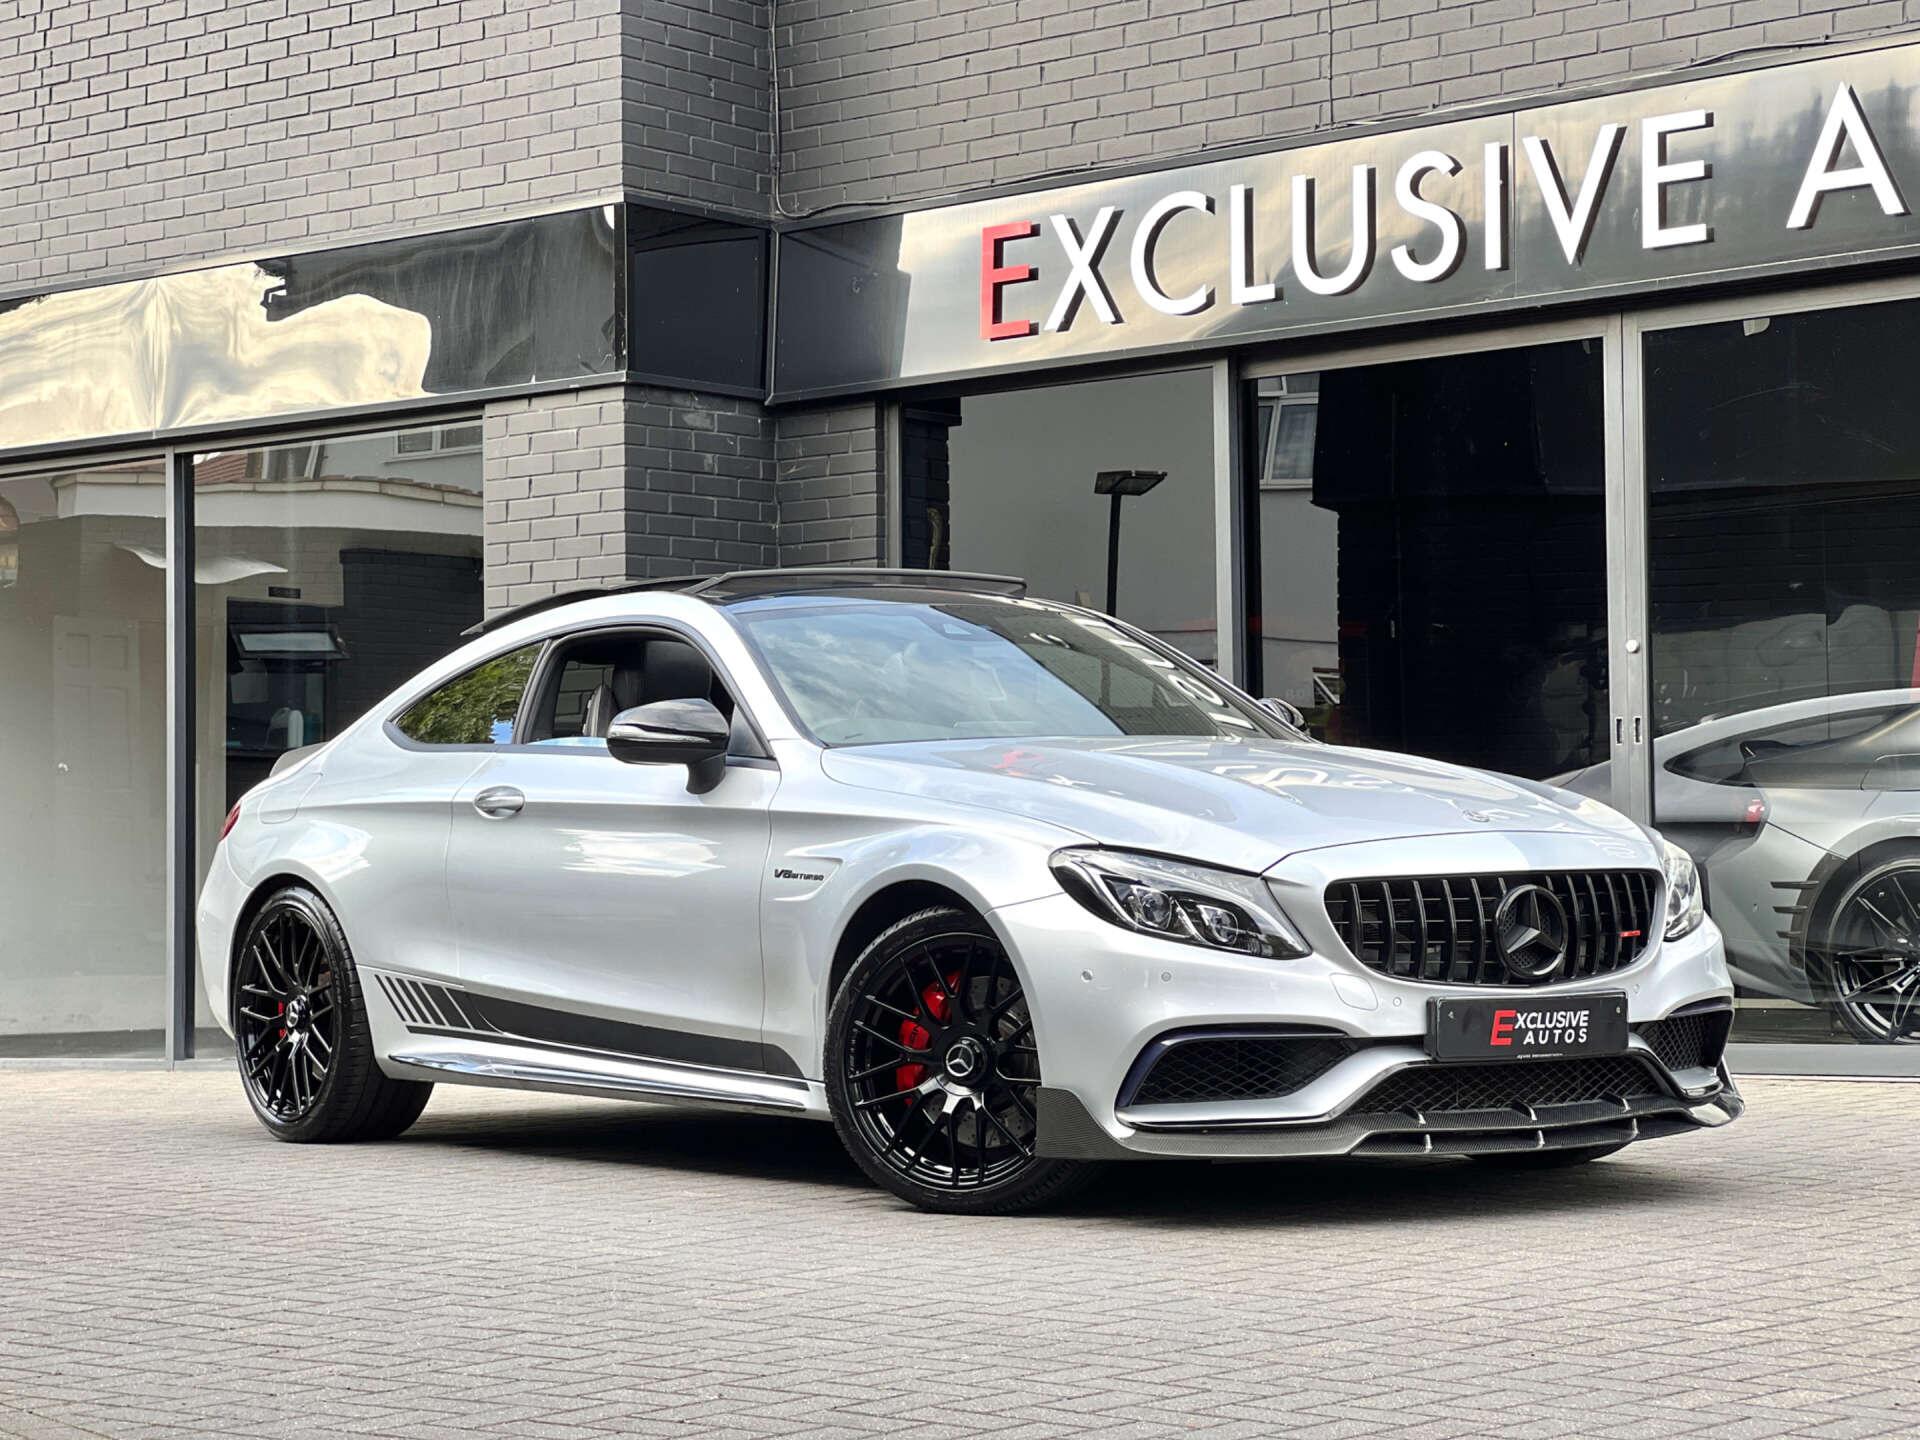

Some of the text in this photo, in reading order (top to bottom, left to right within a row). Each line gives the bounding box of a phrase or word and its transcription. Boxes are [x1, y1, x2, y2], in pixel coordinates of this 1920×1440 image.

[980, 81, 1909, 341] EXCLUSIVE A
[1490, 1009, 1590, 1046] EXCLUSIVE
[1523, 1028, 1588, 1045] AUTOS
